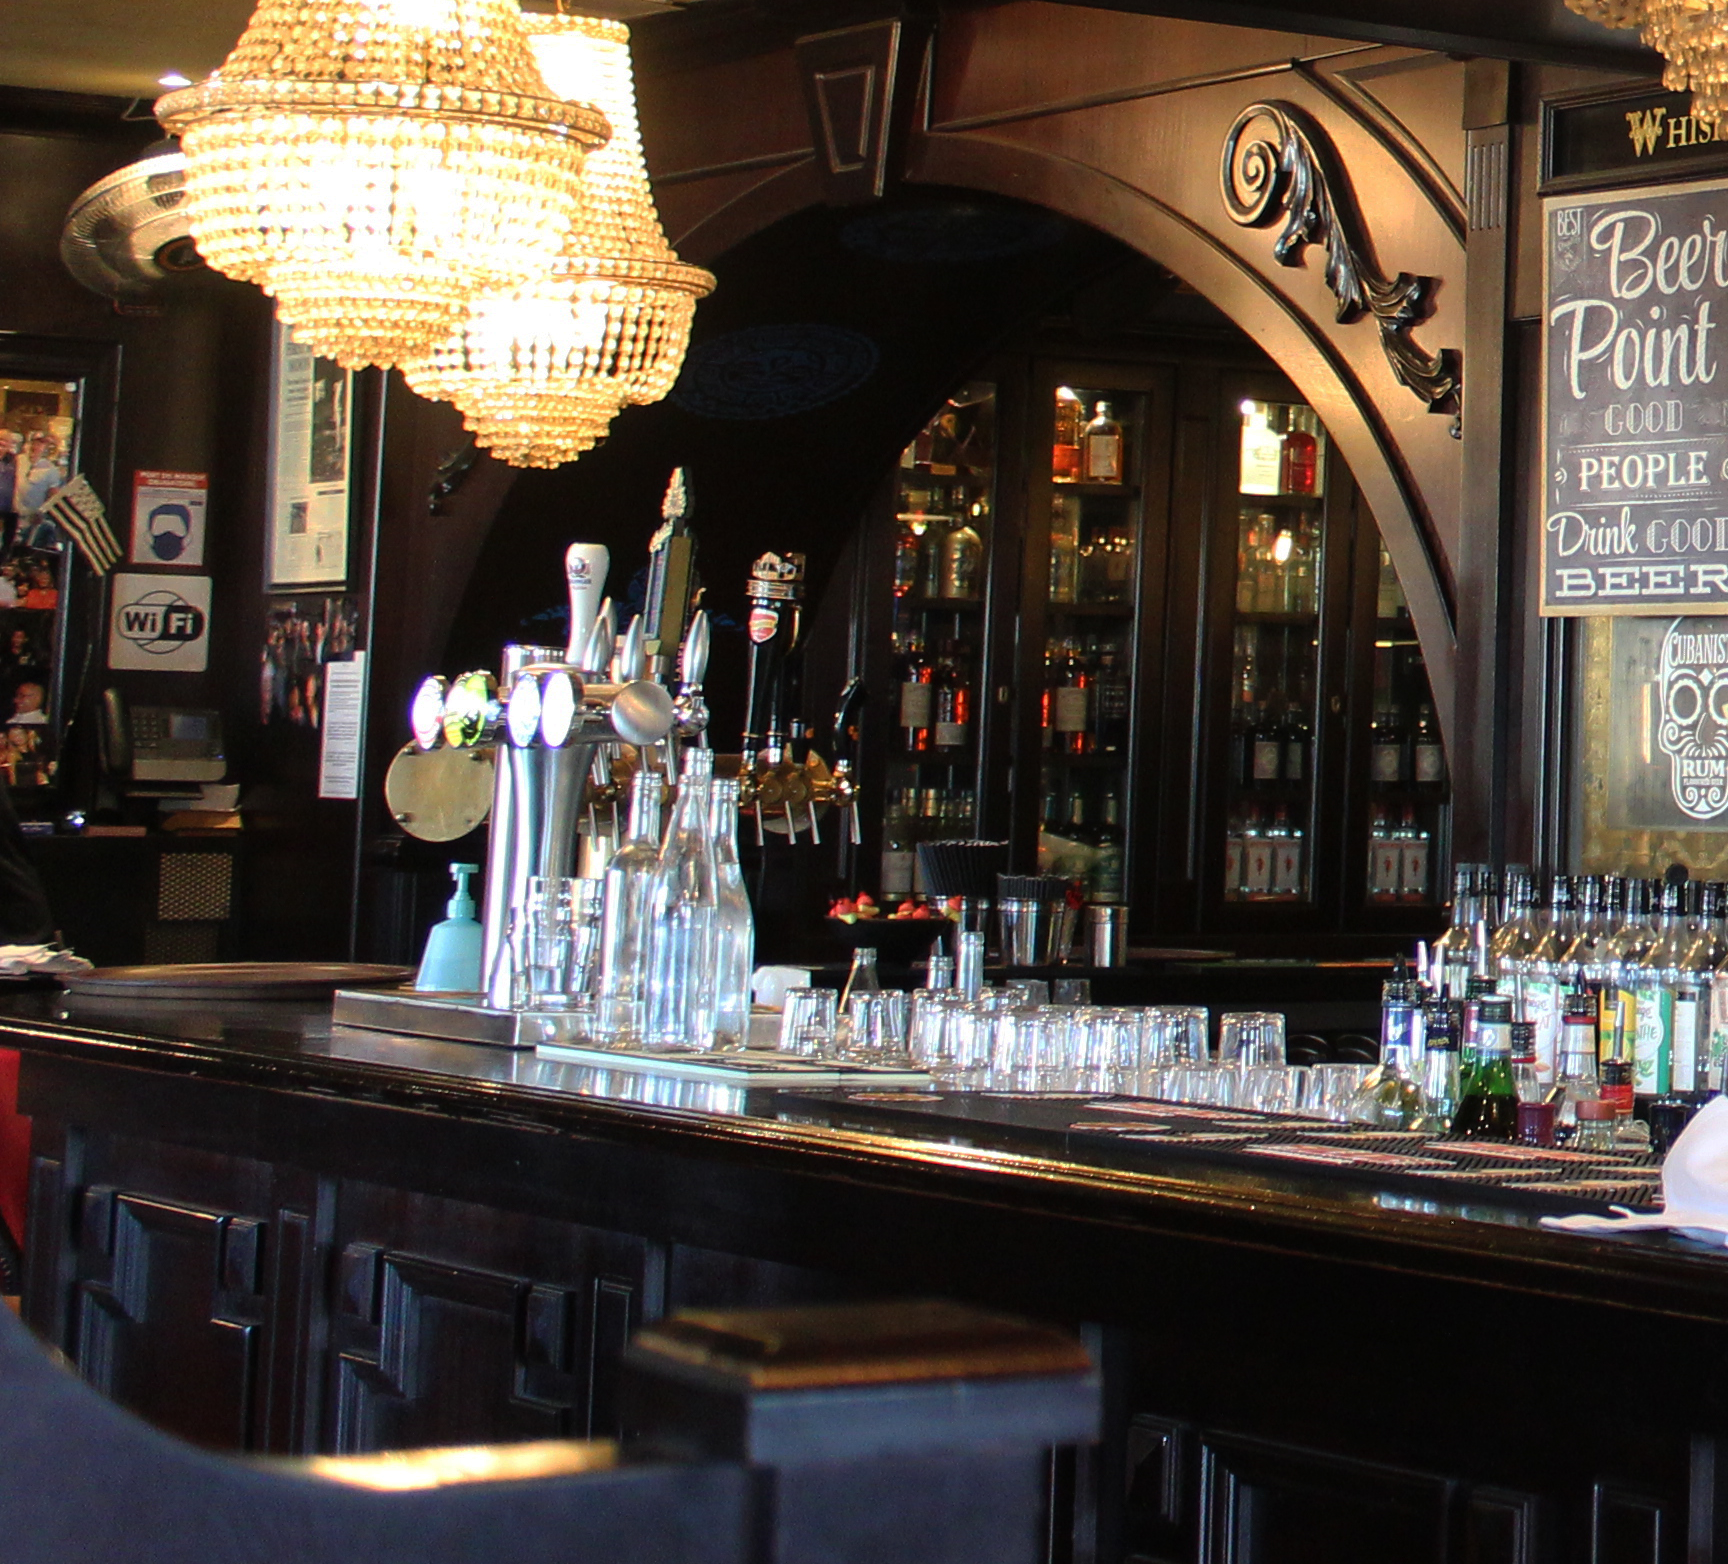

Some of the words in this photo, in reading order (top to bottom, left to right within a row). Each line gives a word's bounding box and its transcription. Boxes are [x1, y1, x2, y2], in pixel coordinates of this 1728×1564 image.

[1557, 208, 1582, 236] BEST
[1550, 299, 1717, 399] Point
[1604, 399, 1683, 436] GOOD
[1579, 450, 1711, 492] PEOPLE
[1547, 506, 1639, 557] Drink
[1682, 759, 1726, 778] RUM
